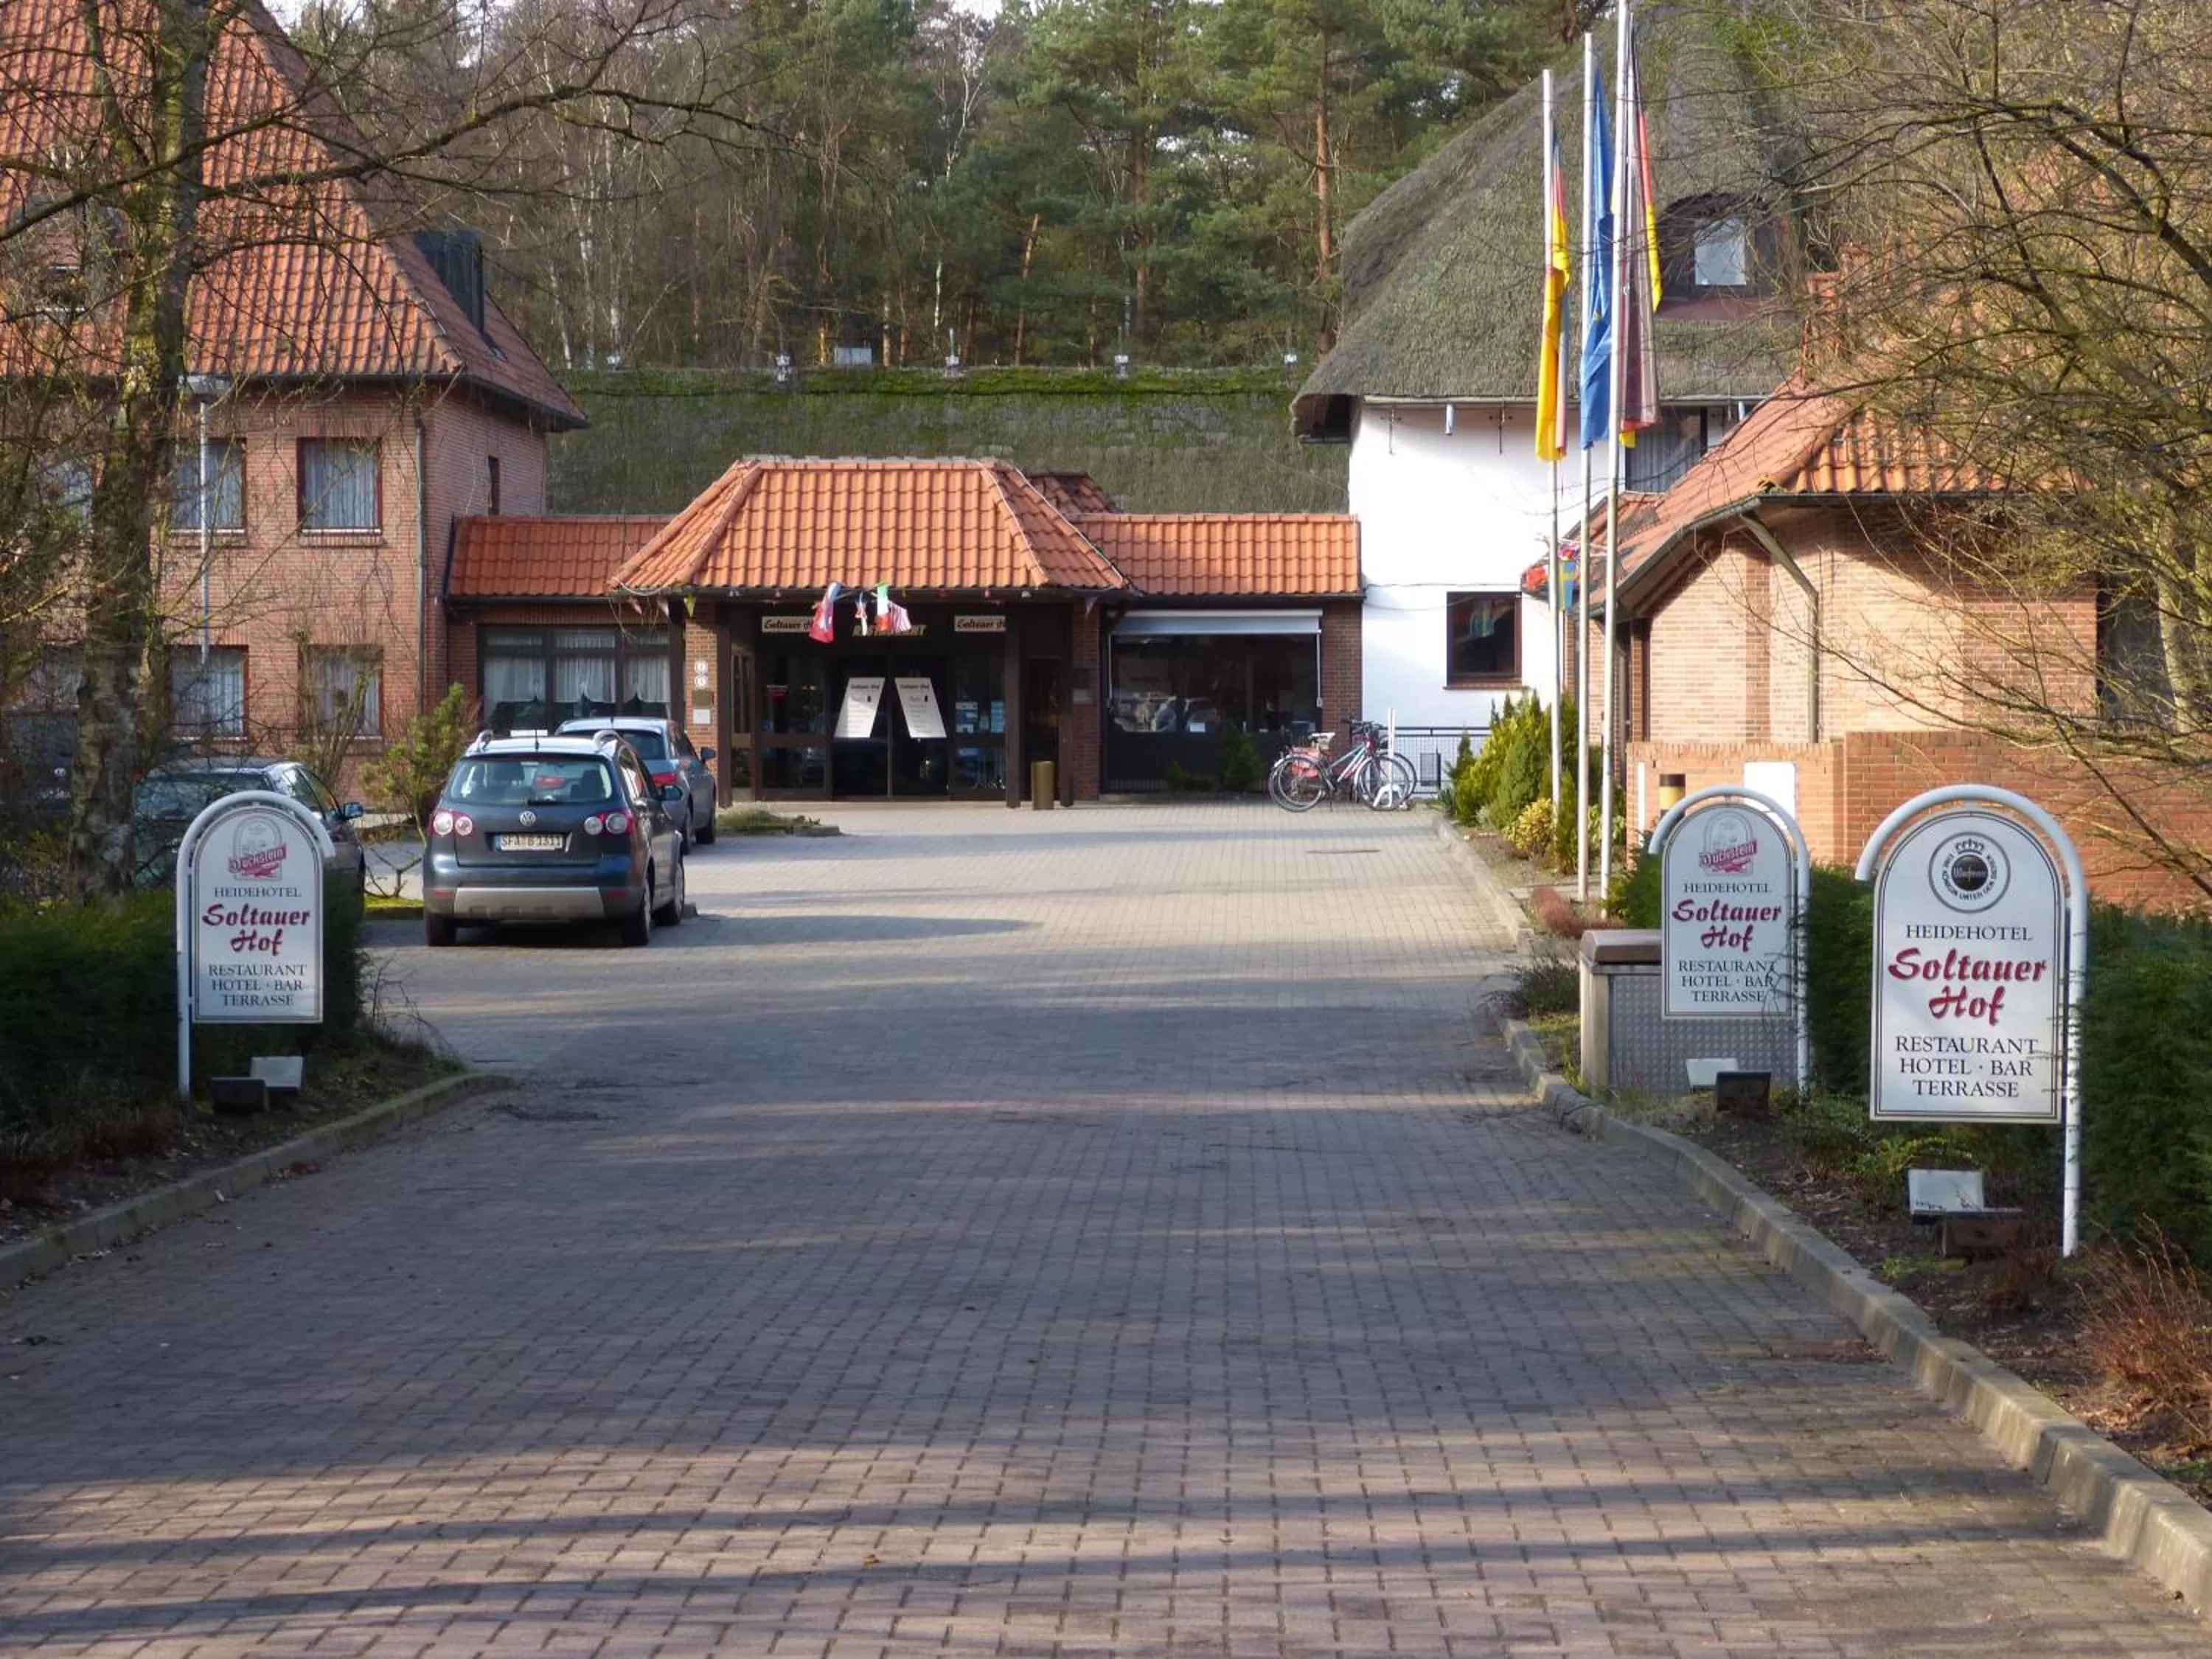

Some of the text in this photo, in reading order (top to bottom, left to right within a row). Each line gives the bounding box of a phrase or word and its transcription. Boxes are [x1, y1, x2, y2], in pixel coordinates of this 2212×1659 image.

[214, 887, 302, 898] HEIDEHOTEL
[1683, 883, 1773, 894] HEIDEHOTEL
[201, 902, 310, 927] Soltauer
[1672, 898, 1782, 922] Soltauer
[229, 928, 283, 956] Hof
[1700, 924, 1754, 953] Hof
[1906, 924, 2033, 942] HEIDEHOTEL
[208, 964, 307, 977] RESTAURANT
[1678, 959, 1777, 973] RESTAURANT
[1887, 947, 2048, 982] Soltauer
[211, 979, 303, 992] HOTEL BAR
[1681, 975, 1773, 988] HOTEL BAR
[222, 994, 294, 1007] TERRASSE
[1691, 990, 1765, 1003] TERRASSE
[1928, 984, 2006, 1027] Hof
[1895, 1035, 2039, 1055] RESTAURANT
[1899, 1057, 2034, 1077] HOTEL BAR
[1911, 1079, 2020, 1099] TERRASSE
